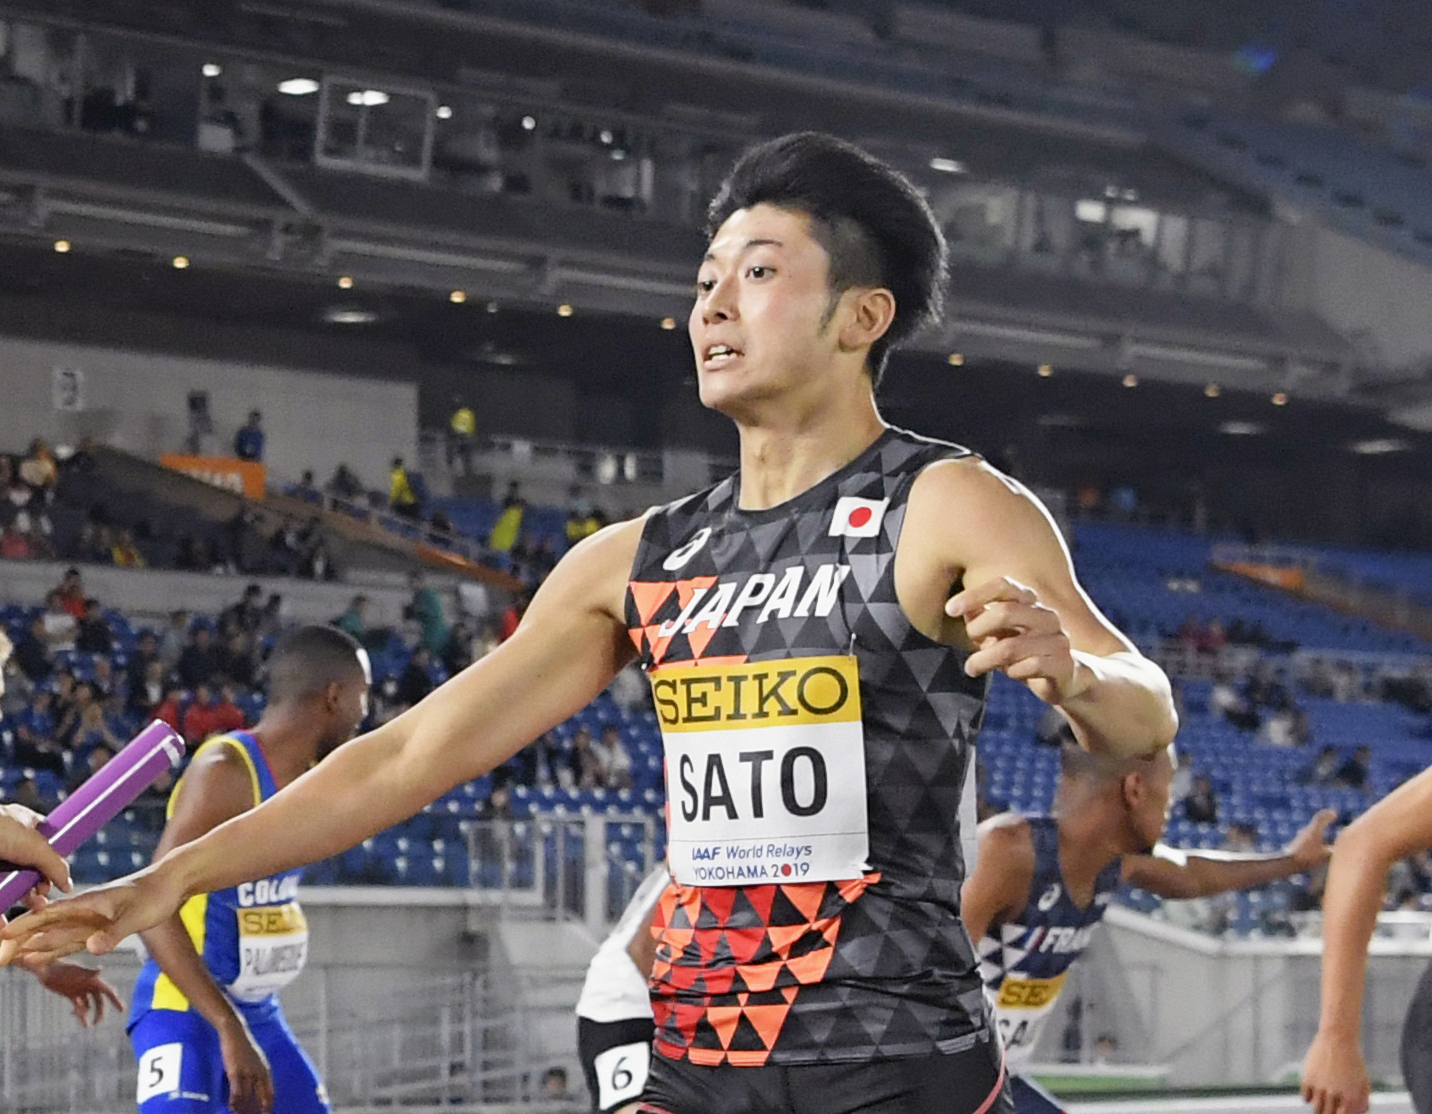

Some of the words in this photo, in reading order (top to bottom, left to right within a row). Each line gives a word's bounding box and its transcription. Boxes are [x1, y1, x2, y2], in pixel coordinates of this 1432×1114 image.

[658, 564, 851, 638] JAPAN
[654, 666, 849, 726] SEIKO
[679, 746, 828, 822] SATO
[692, 847, 721, 861] IAAF
[726, 845, 763, 859] World
[766, 844, 812, 861] Relays
[693, 865, 768, 880] YOKOHAMA
[149, 1056, 165, 1088] 5
[611, 1056, 633, 1091] 6
